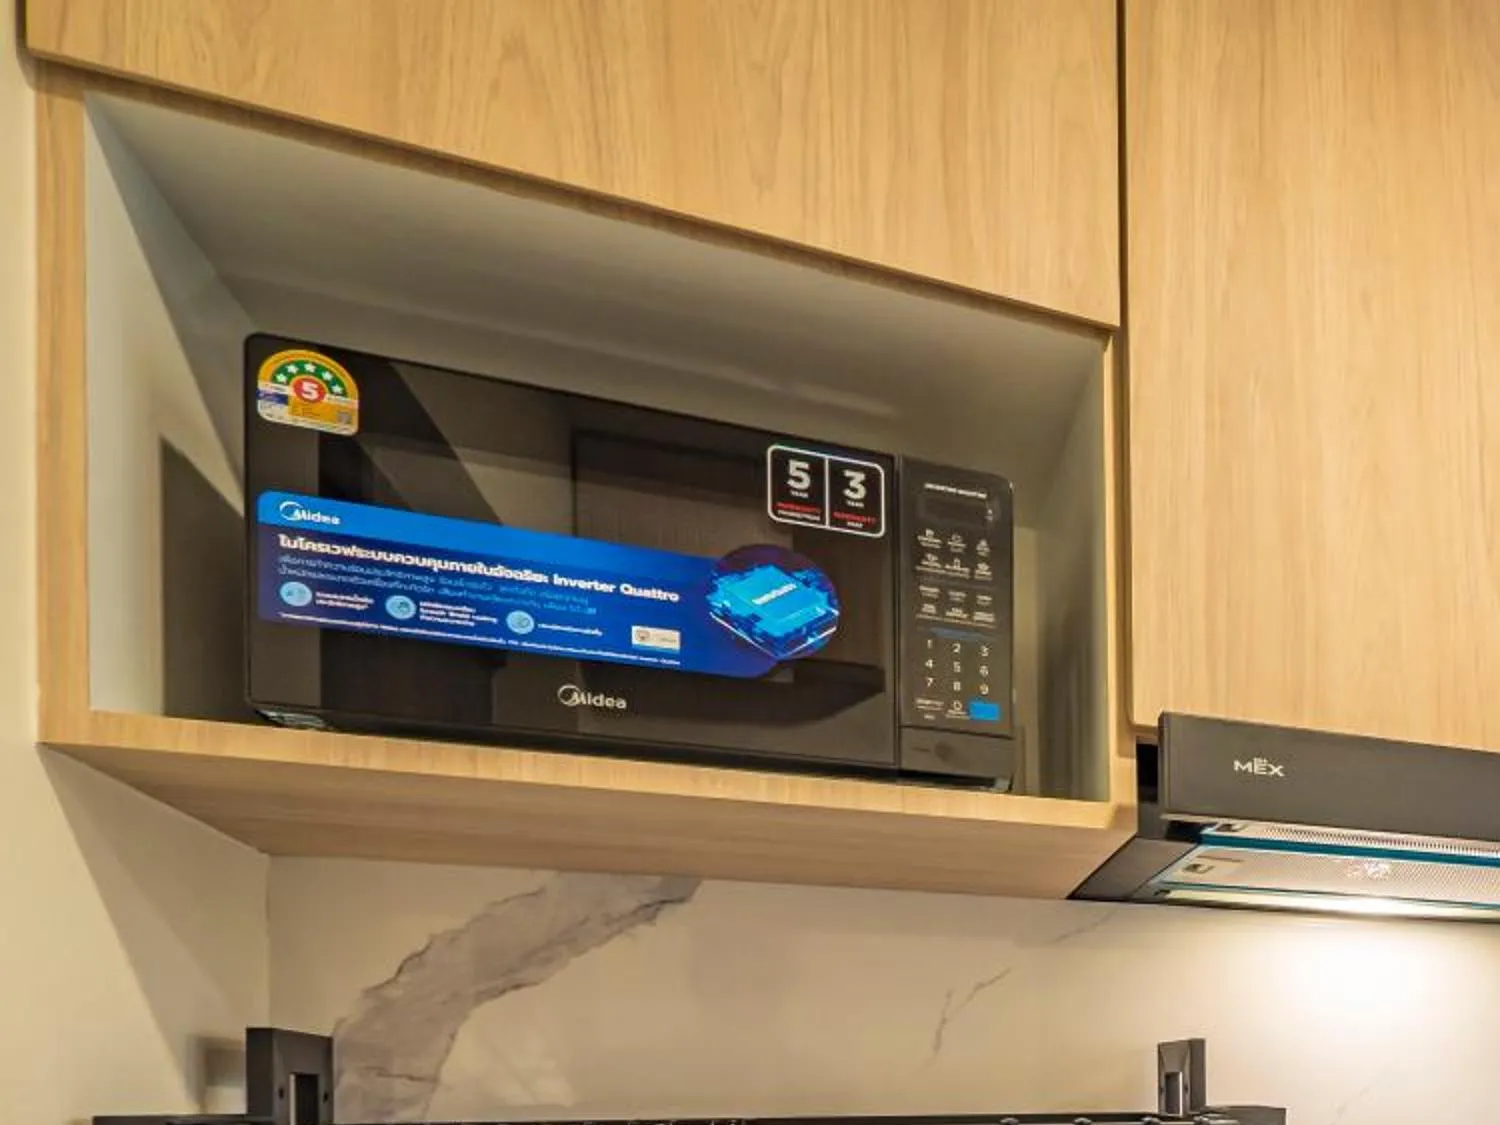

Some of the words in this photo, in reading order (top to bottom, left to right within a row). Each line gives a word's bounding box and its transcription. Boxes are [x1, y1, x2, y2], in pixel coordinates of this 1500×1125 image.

[300, 381, 320, 401] 5
[786, 459, 811, 490] 5
[843, 469, 866, 499] 3
[279, 500, 341, 526] Midea
[553, 573, 617, 594] Inverter
[619, 583, 680, 603] Quattro
[557, 684, 628, 710] Midea
